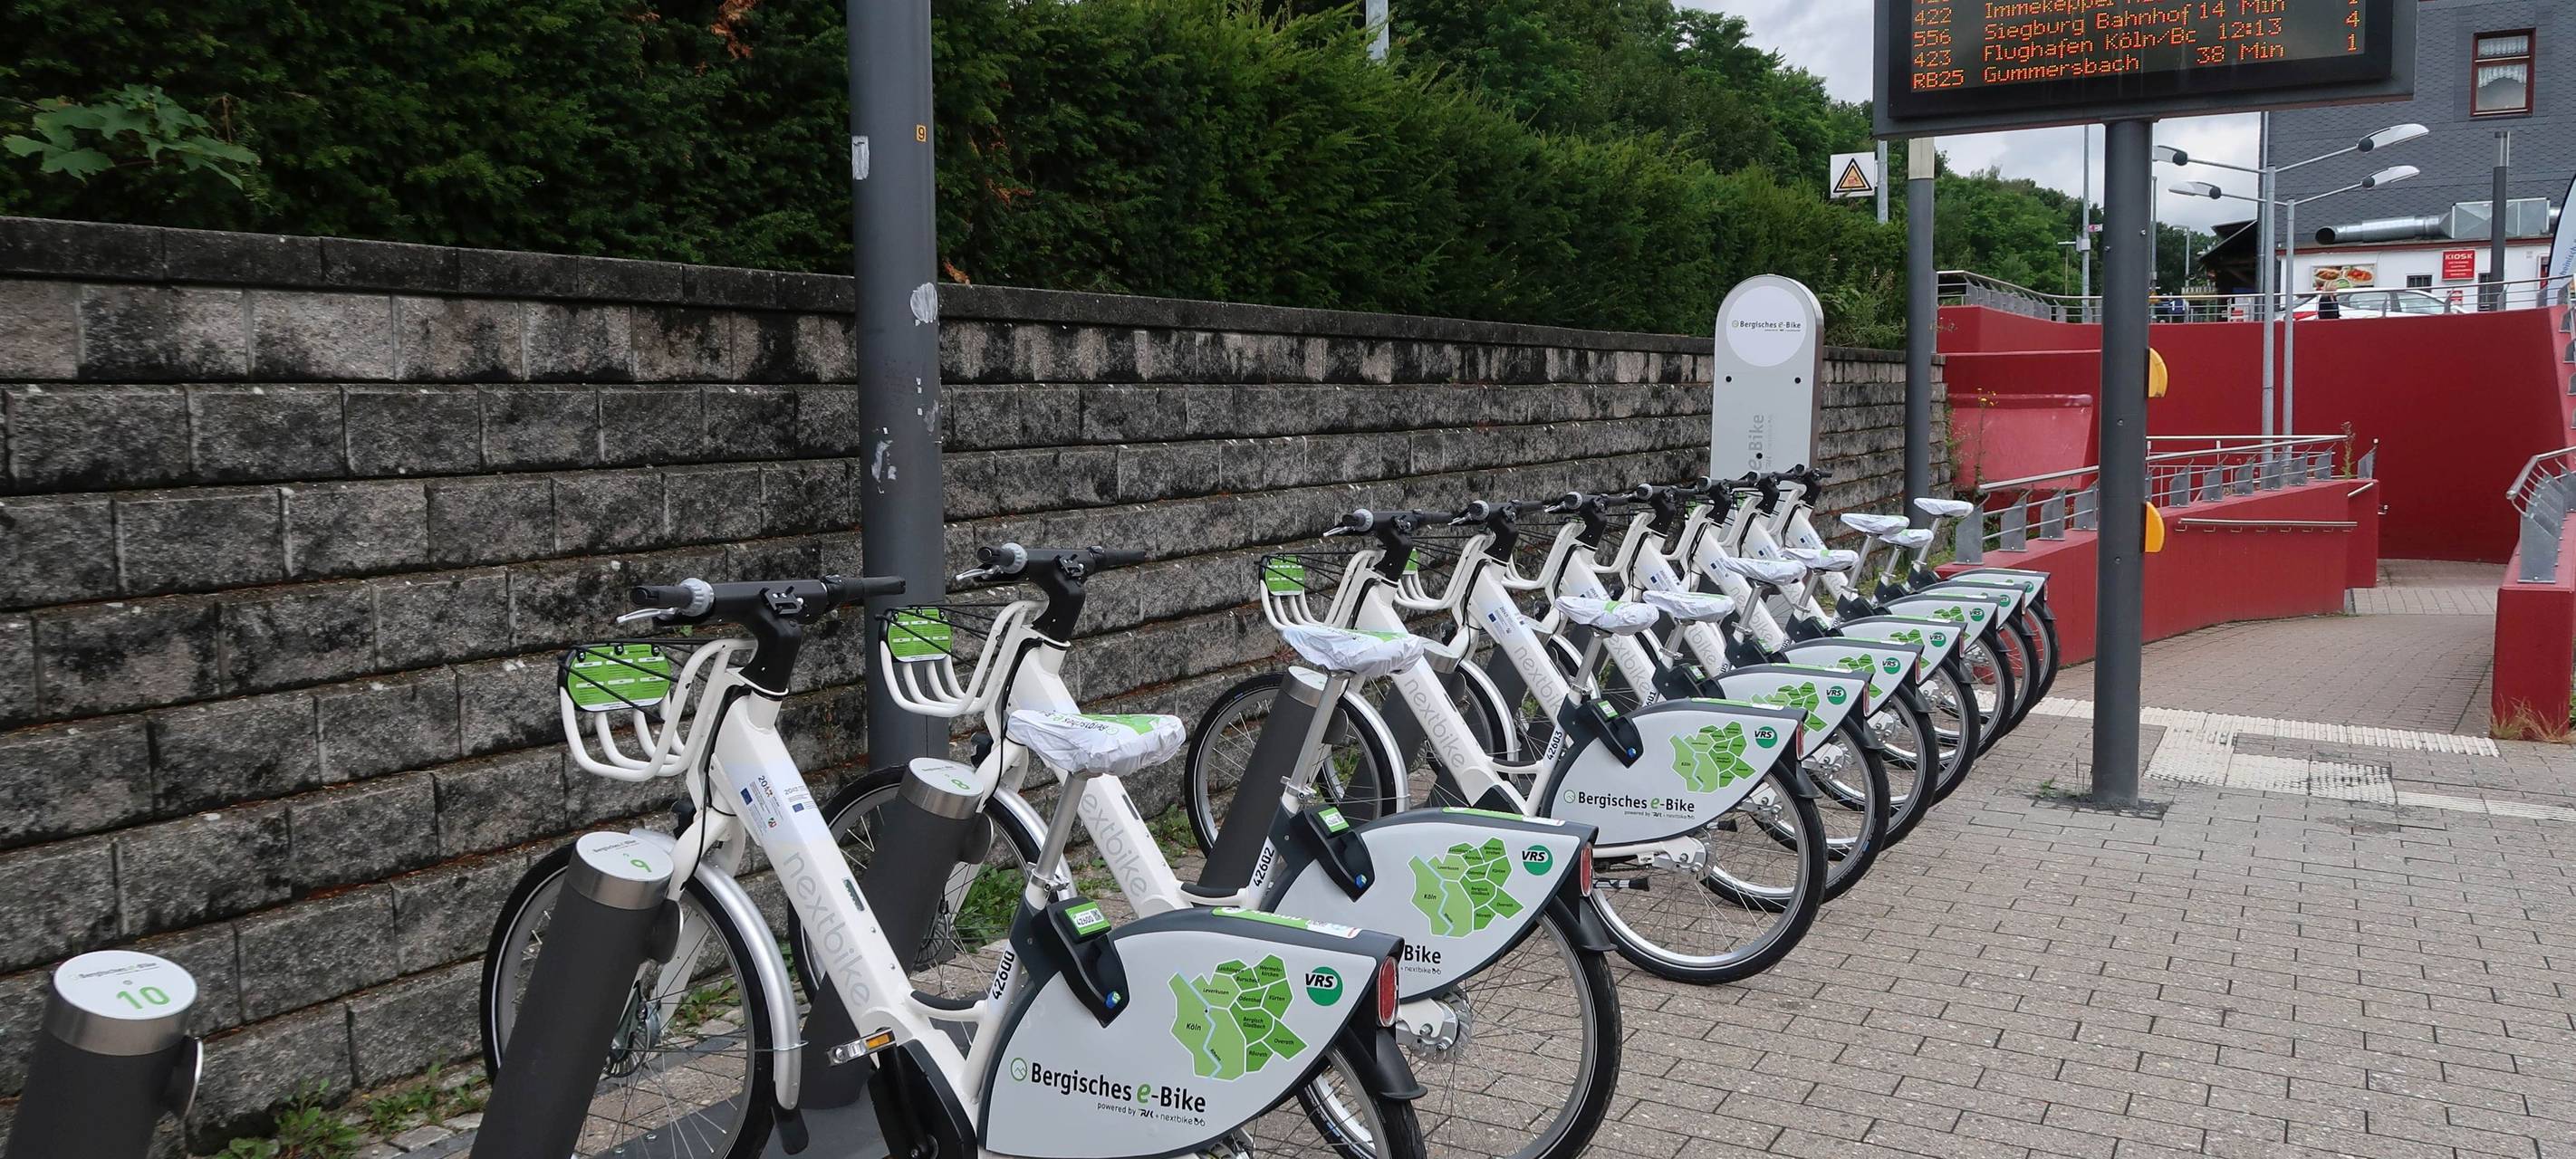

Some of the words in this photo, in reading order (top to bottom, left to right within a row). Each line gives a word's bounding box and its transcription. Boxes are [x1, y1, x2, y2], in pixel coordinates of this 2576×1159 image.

[1913, 29, 1952, 47] 556
[1985, 18, 2085, 41] Siegburg
[2096, 3, 2192, 30] Bahnhof
[2199, 0, 2225, 20] 14
[2241, 0, 2286, 15] Min
[1914, 7, 1952, 25] 422
[1914, 49, 1952, 68] 423
[1984, 38, 2093, 62] Flughafen
[2105, 26, 2196, 51] Köln/Bc
[2219, 17, 2283, 41] 12:13
[2345, 10, 2360, 30] 4
[1913, 69, 1965, 90] RB25
[1984, 54, 2140, 83] Gummersbach
[2196, 45, 2225, 64] 38
[2239, 42, 2284, 62] Min
[2347, 34, 2357, 53] 1
[918, 127, 925, 140] 9
[2445, 253, 2474, 261] KIOSK
[1740, 321, 1777, 330] Bergisches
[1405, 677, 1466, 770] nextbike
[1754, 730, 1773, 739] VRS
[1546, 730, 1563, 761] 42603
[951, 779, 971, 790] 8
[1578, 791, 1648, 809] Bergisches
[1650, 798, 1695, 812] e-Bike
[1081, 792, 1148, 897] extbike
[630, 859, 652, 873] 9
[1253, 847, 1275, 887] 42602
[1521, 850, 1545, 862] VRS
[783, 851, 870, 1007] nextbike
[992, 950, 1015, 1001] 42600
[1305, 972, 1334, 989] VRS
[116, 986, 170, 1010] 10
[1186, 1022, 1202, 1031] Köln
[1274, 1038, 1294, 1046] Overath
[1031, 1062, 1132, 1101] Bergisches
[1136, 1084, 1206, 1113] e-Bike
[1097, 1102, 1127, 1114] powered
[1129, 1106, 1137, 1116] by
[1160, 1114, 1194, 1125] nextbike
